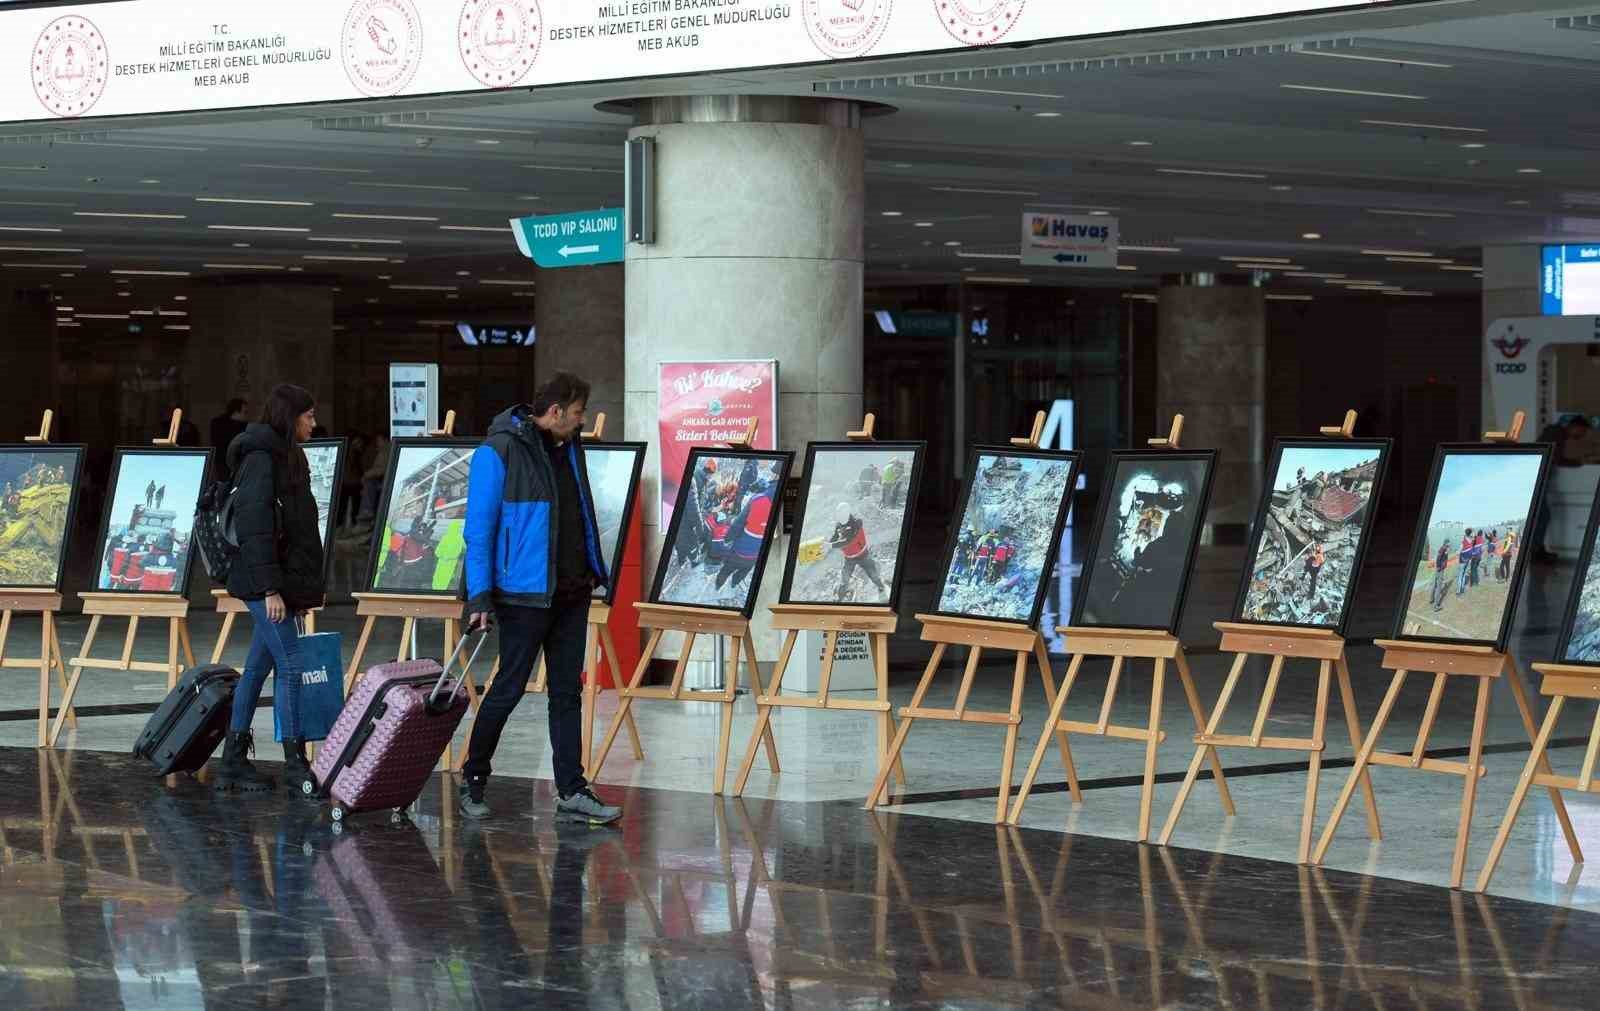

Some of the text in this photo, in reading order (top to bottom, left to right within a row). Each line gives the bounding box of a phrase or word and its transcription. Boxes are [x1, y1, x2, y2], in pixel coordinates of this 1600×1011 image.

[213, 24, 231, 35] T.C.
[550, 27, 595, 41] DESTEK
[599, 19, 667, 36] HİZMETLERİ
[671, 15, 710, 29] GENEL
[159, 42, 187, 57] MİLLİ
[638, 34, 699, 51] MEB AKUB
[115, 63, 156, 76] DESTEK
[159, 57, 221, 73] HİZMETLERİ
[224, 54, 259, 69] GENEL
[194, 72, 250, 87] MEB AKUB
[533, 216, 617, 238] TCDD VIP SALONU
[1052, 218, 1109, 243] Havaş
[479, 328, 487, 344] 4
[682, 416, 710, 426] ANKARA
[675, 429, 708, 441] Sizleri
[302, 665, 328, 685] mavi
